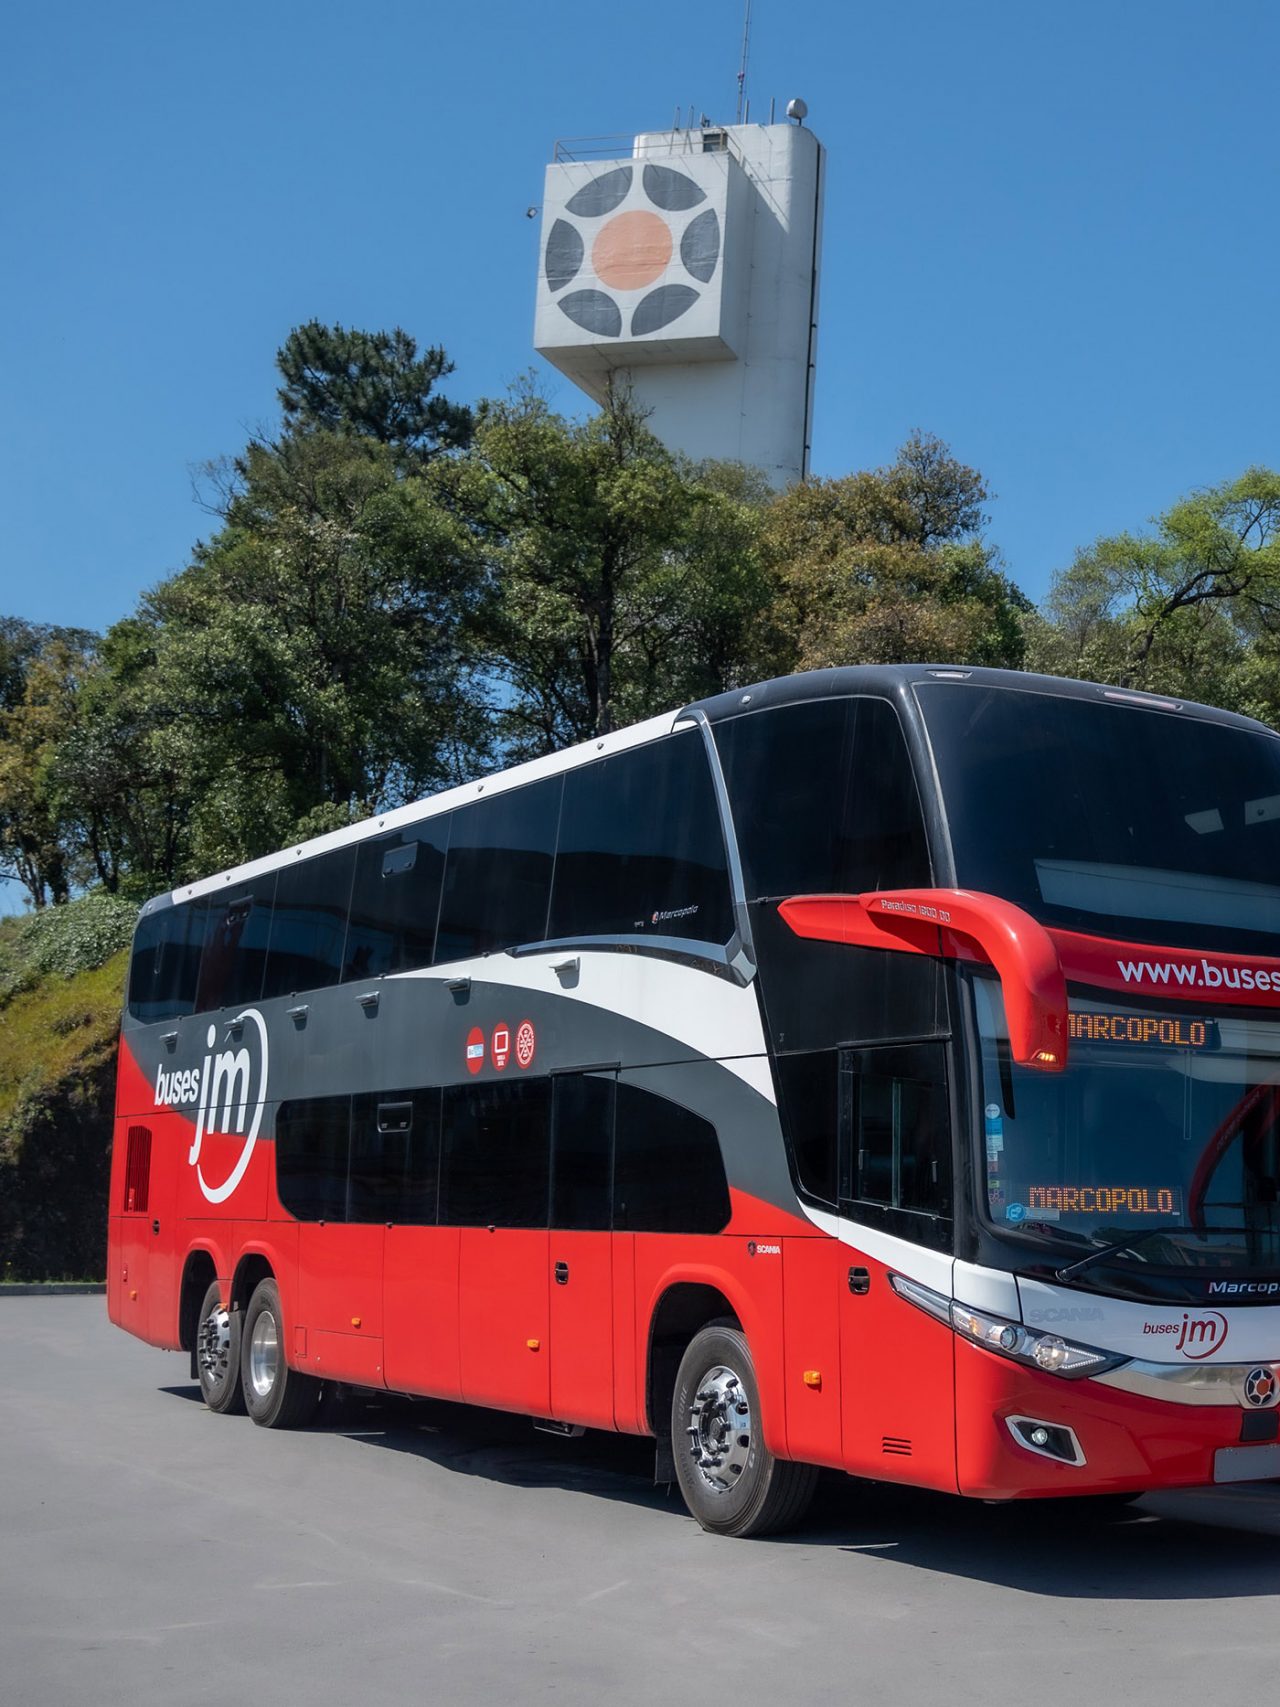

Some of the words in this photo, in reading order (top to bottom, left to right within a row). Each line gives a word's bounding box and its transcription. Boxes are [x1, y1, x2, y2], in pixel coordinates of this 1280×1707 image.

[881, 899, 917, 913] Paradiso
[154, 1063, 200, 1106] buses
[1029, 1186, 1173, 1213] MARCOPOLO
[756, 1244, 780, 1254] SCANIA
[1029, 1307, 1106, 1323] SCANIA
[1143, 1322, 1180, 1335] buses
